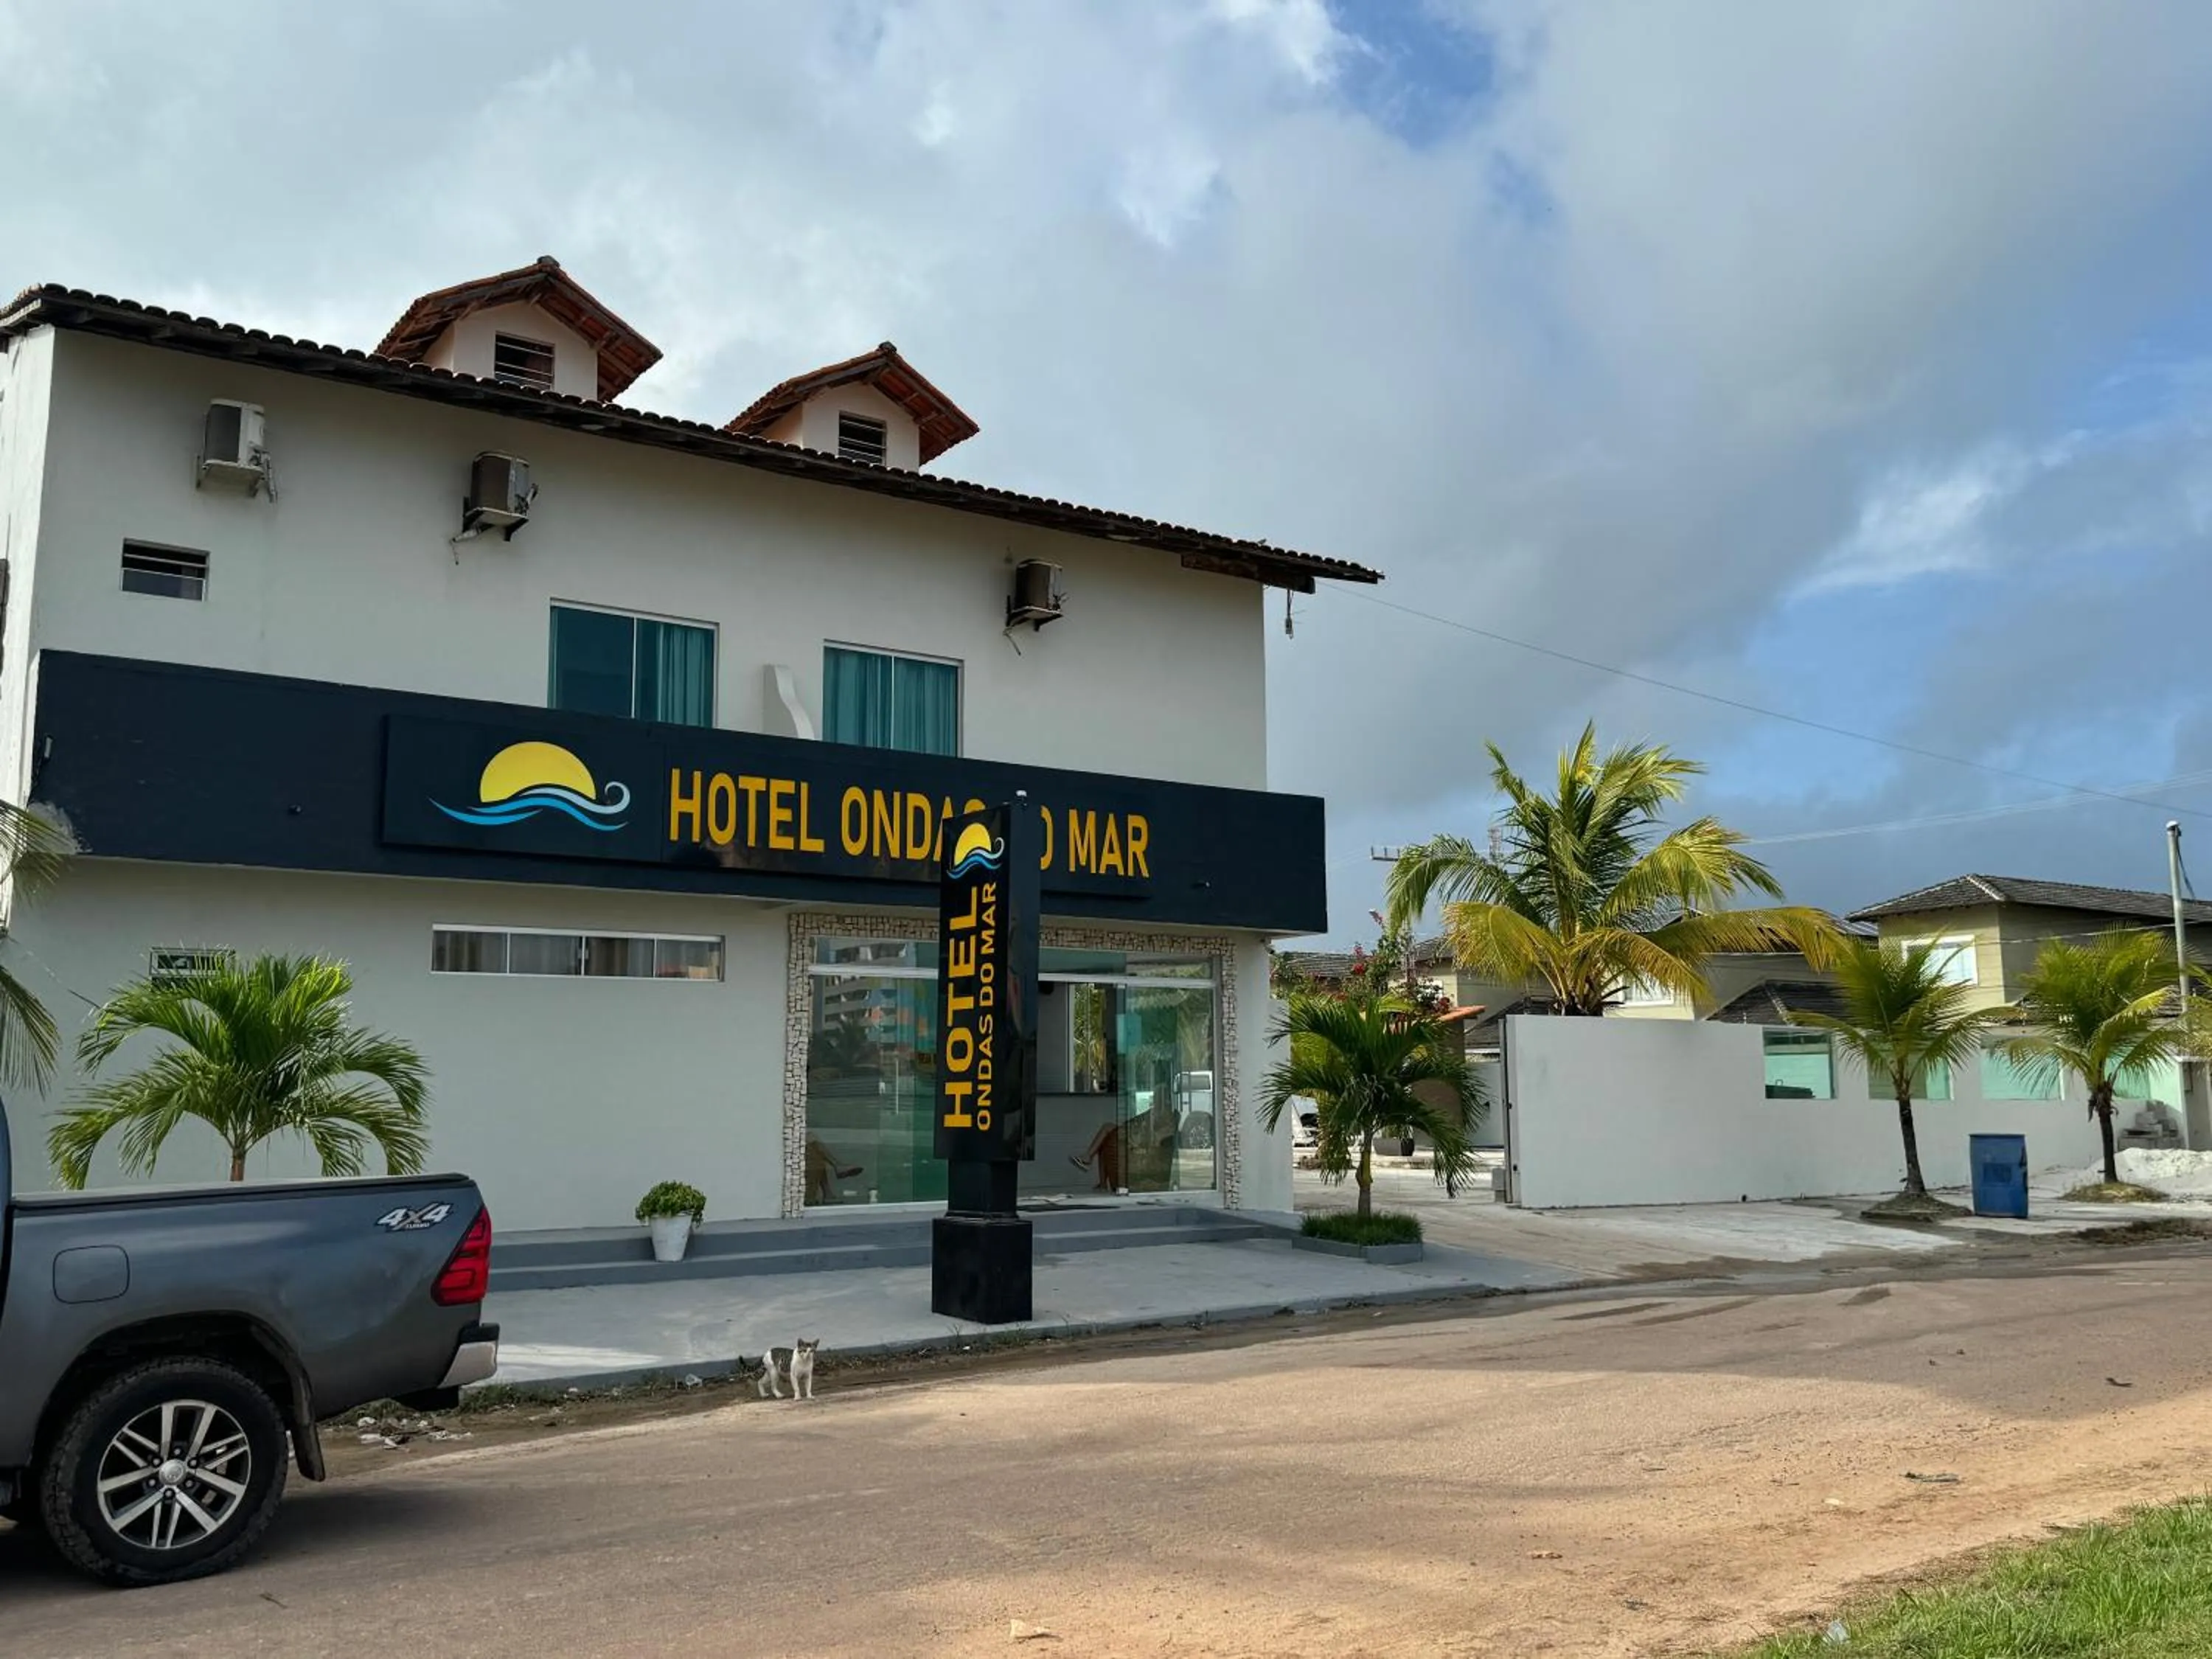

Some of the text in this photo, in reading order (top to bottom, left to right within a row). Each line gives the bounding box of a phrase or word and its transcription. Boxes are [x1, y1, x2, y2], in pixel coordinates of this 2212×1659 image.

[669, 768, 824, 852] HOTEL
[841, 786, 986, 862] ONDA
[1068, 809, 1149, 878] MAR
[944, 886, 977, 1127] HOTEL
[977, 882, 996, 1130] ONDAS DO MAR
